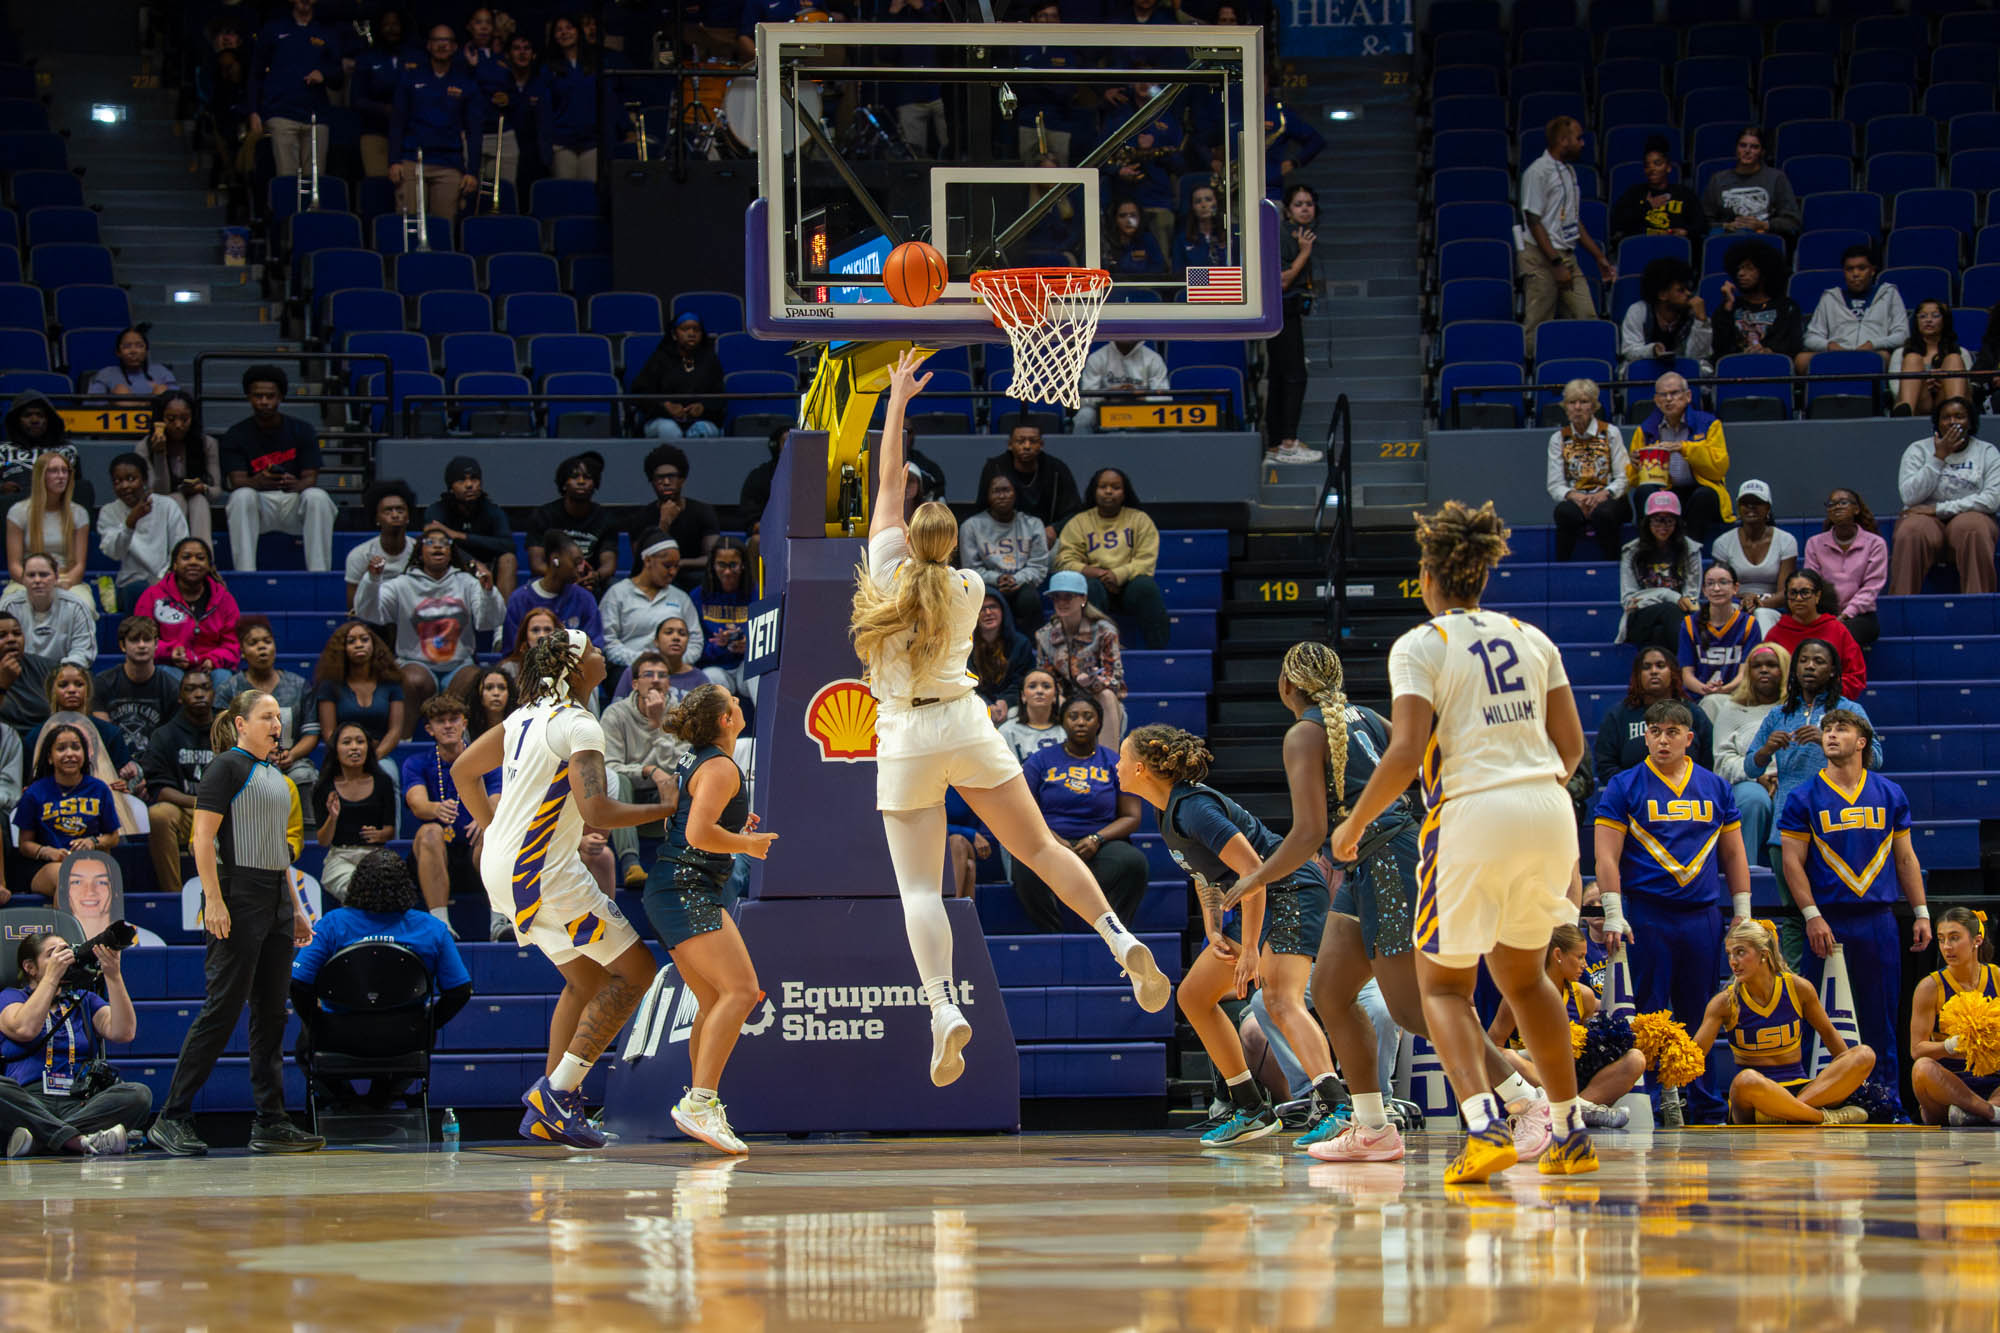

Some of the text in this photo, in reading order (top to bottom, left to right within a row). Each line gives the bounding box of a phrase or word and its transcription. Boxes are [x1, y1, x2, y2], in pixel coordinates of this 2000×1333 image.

[785, 307, 834, 319] SPALDING
[96, 413, 152, 430] 119
[1152, 407, 1206, 425] 119
[1380, 442, 1420, 458] 227
[983, 537, 1034, 556] LSU
[1086, 527, 1136, 554] LSU
[1259, 581, 1299, 602] 119
[747, 608, 779, 662] YETI
[1468, 638, 1525, 695] 12
[1696, 645, 1743, 665] LSU
[1483, 700, 1536, 726] WILLIAM
[514, 717, 534, 761] 1
[1044, 766, 1110, 783] LSU
[42, 797, 101, 821] LSU
[1647, 799, 1713, 822] LSU
[1819, 806, 1886, 833] LSU
[4, 924, 54, 940] LSU
[782, 1014, 885, 1041] Share
[1735, 1019, 1800, 1050] LSU
